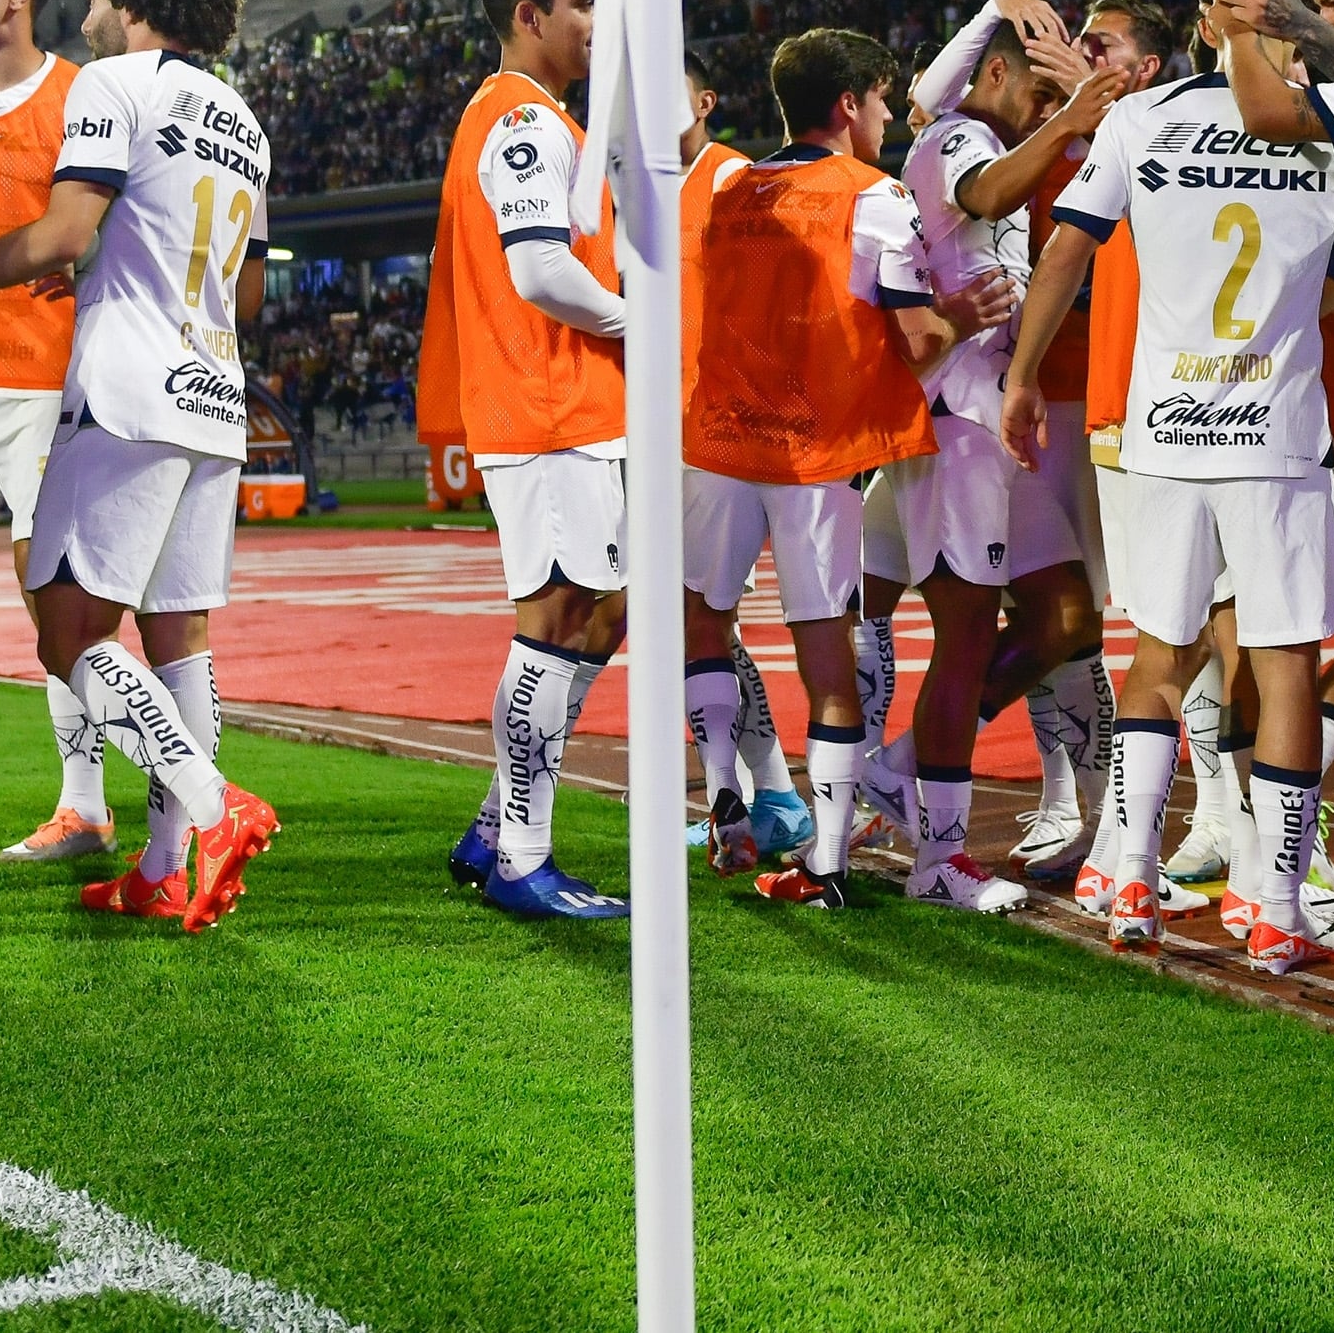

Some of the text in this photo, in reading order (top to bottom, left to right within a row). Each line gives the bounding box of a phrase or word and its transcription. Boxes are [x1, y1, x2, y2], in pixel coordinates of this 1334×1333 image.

[63, 116, 114, 141] obil
[202, 100, 263, 155] telcel
[515, 162, 546, 184] Berel
[1177, 165, 1327, 193] SUZUKI
[514, 198, 549, 213] GNP
[184, 174, 253, 311] 12
[1212, 201, 1262, 340] 2
[1146, 391, 1272, 429] Caliente
[1153, 428, 1267, 448] caliente.mx
[443, 445, 467, 491] G
[252, 490, 265, 512] G
[505, 661, 546, 826] BRIDGESTONE
